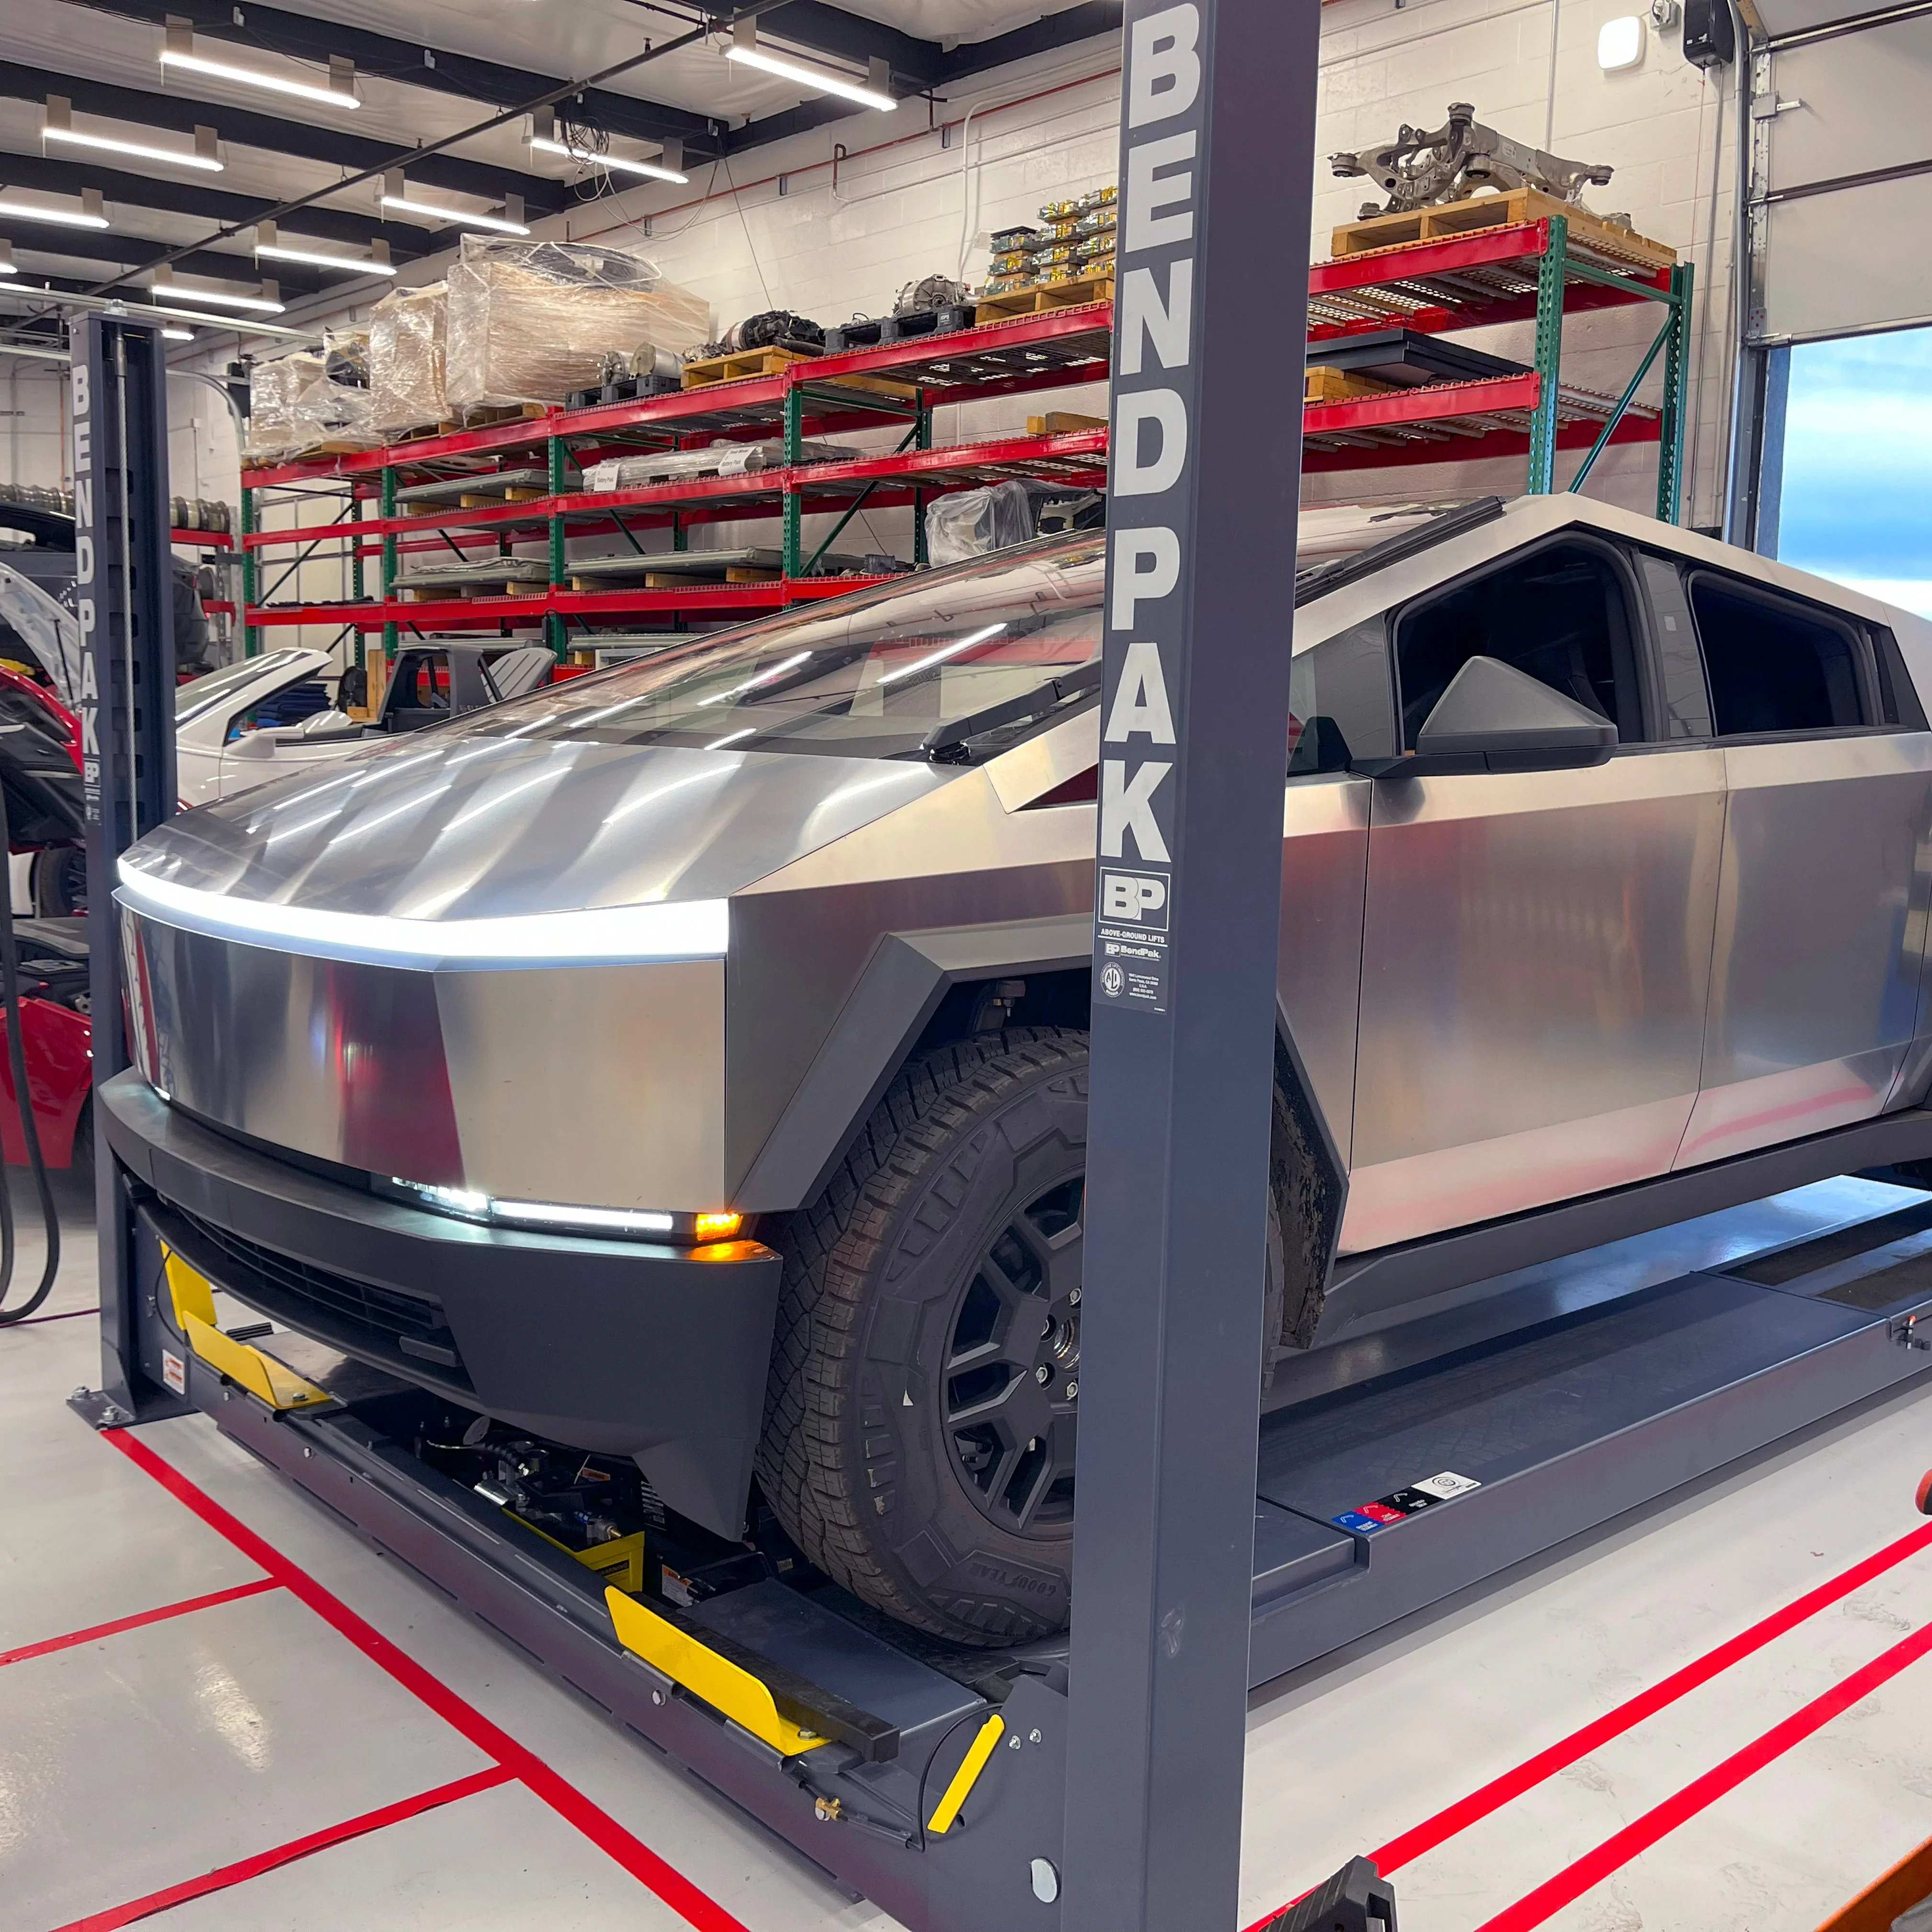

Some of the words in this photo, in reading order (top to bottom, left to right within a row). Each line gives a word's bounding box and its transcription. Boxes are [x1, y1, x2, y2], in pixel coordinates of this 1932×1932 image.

[1100, 3, 1200, 862] BENDPAK
[72, 365, 100, 755] BENDPAK
[1103, 874, 1165, 921] BP
[1101, 928, 1147, 942] ABOVE-GROUND
[1148, 935, 1165, 943] LIFTS
[1106, 943, 1120, 955] BP
